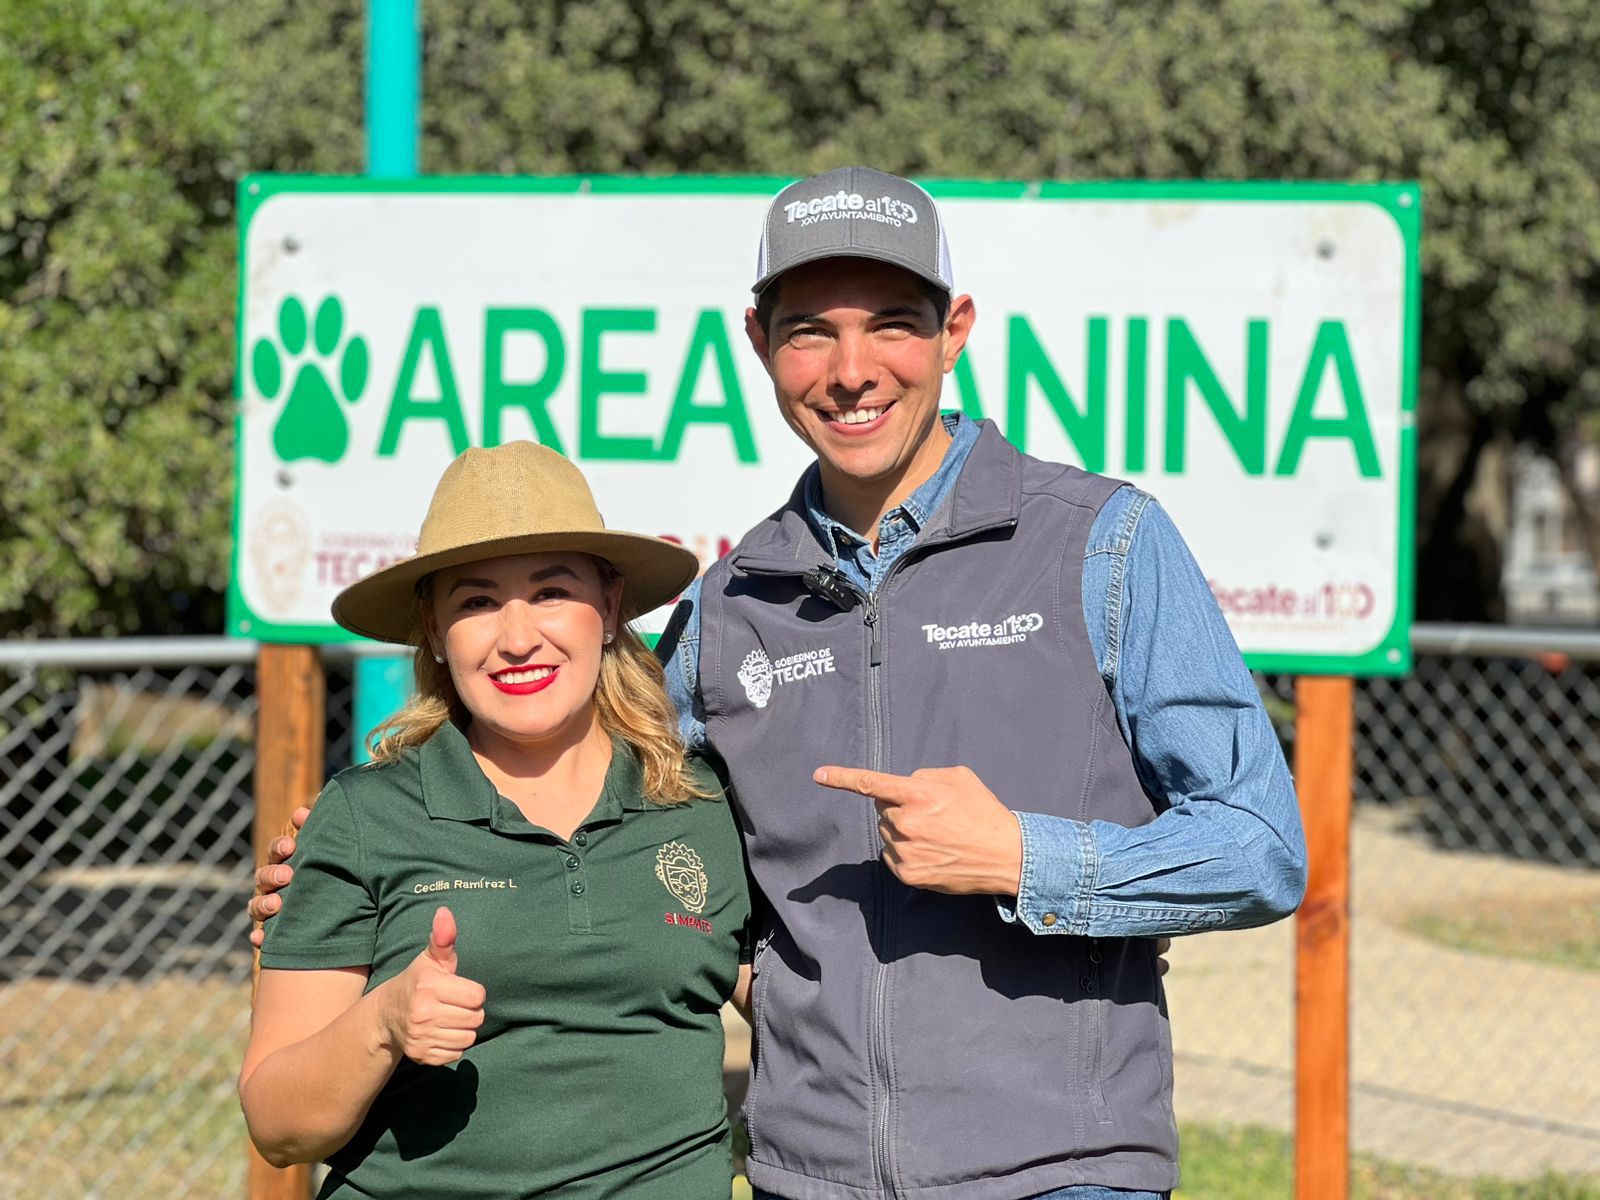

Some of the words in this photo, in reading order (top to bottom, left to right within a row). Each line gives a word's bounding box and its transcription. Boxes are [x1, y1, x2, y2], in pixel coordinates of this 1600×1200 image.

[784, 190, 864, 224] Tecate
[800, 214, 820, 227] XXV
[820, 210, 902, 227] AYUNTAMIENTO
[374, 305, 761, 465] AREA
[940, 315, 1384, 479] NINA
[1207, 579, 1298, 616] ecate
[921, 621, 991, 643] Tecate
[939, 639, 957, 650] XXV
[956, 633, 1027, 648] AYUNTAMIENTO
[774, 650, 818, 669] GOBIERNO
[818, 647, 832, 658] DE
[772, 656, 836, 686] TECATE
[413, 880, 450, 894] Cecilia
[453, 876, 506, 889] Ramírez
